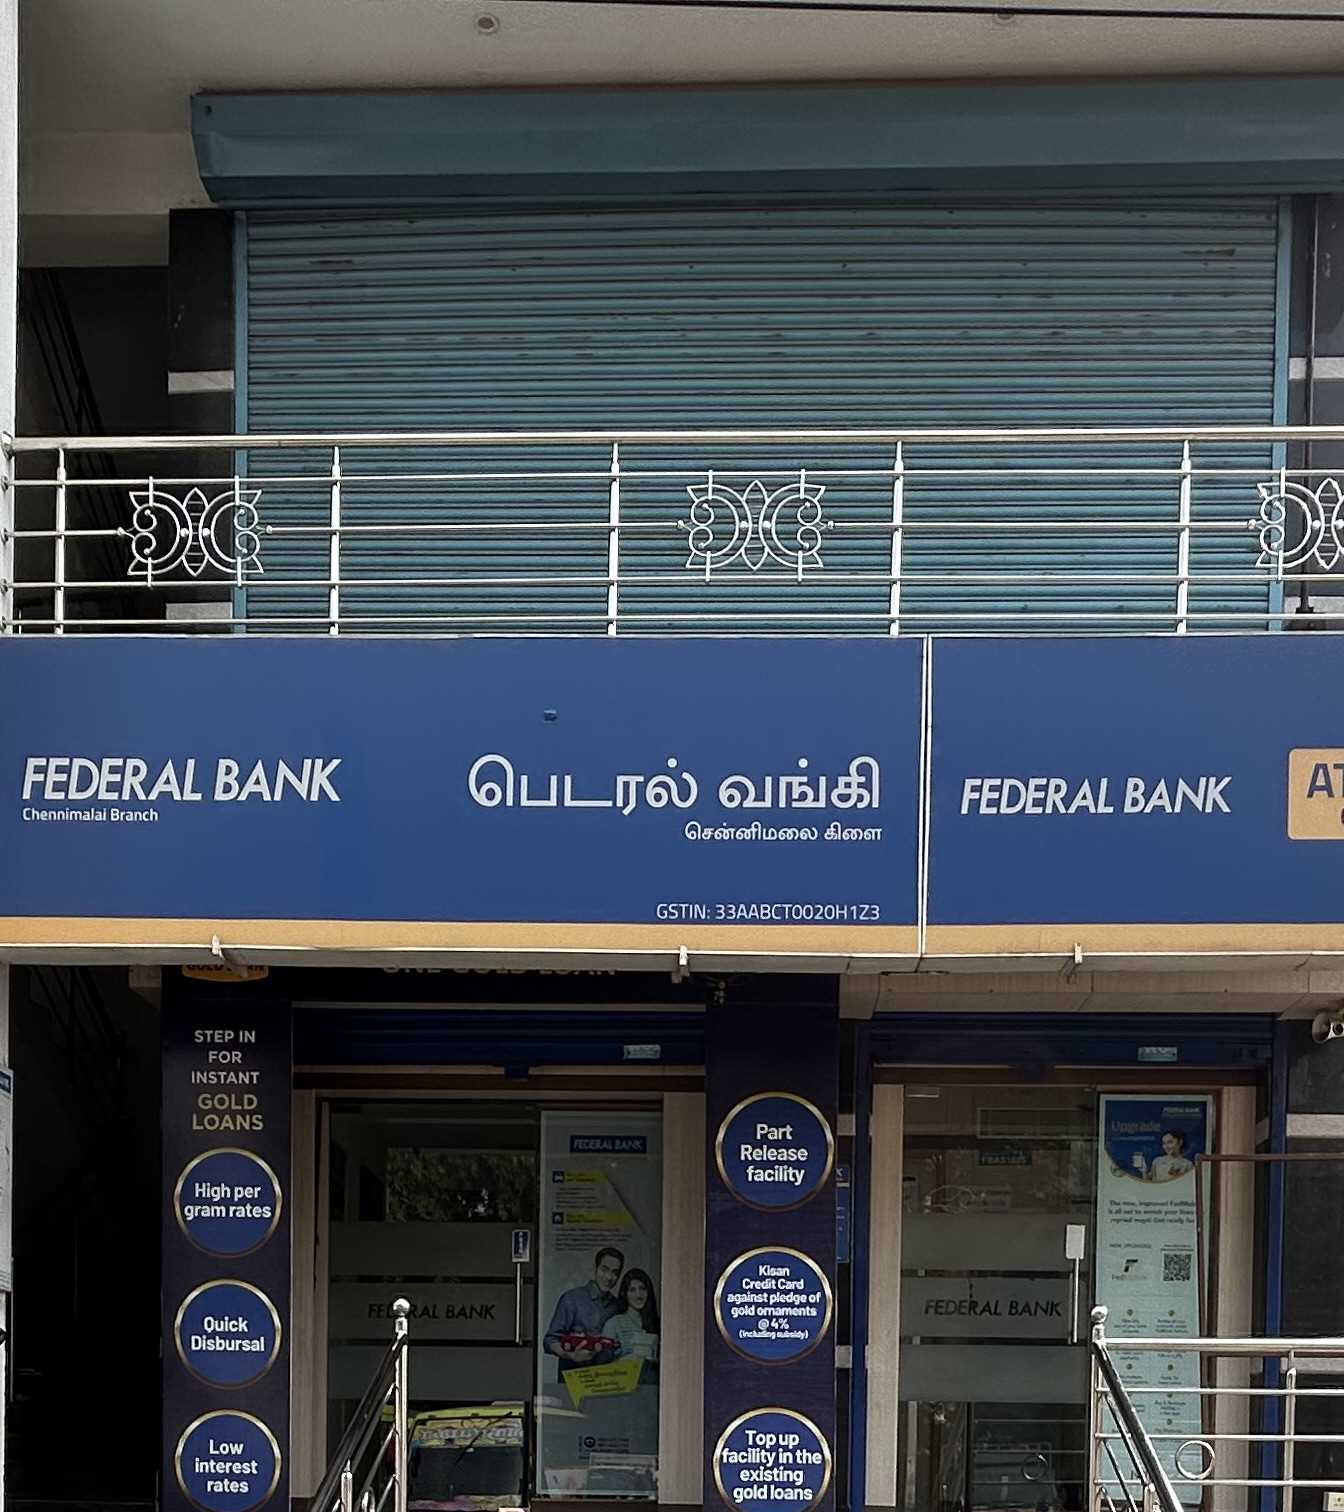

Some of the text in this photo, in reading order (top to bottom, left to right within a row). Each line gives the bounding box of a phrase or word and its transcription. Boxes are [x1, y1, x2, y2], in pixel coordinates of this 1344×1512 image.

[22, 756, 341, 802] FEDERAL BANK
[466, 752, 881, 816] பெடரல் வங்கி
[960, 775, 1231, 815] FEDERAL BANK
[22, 806, 158, 822] Chennimalai Branch
[684, 818, 882, 843] சென்னிமலை கிளை
[656, 903, 880, 920] GSTIN: 33AABCT0020H1Z3
[194, 1029, 256, 1043] STEP IN
[208, 1051, 242, 1064] FOR
[191, 1071, 260, 1084] INSTANT
[197, 1093, 258, 1110] GOLD
[192, 1114, 264, 1130] LOANS
[756, 1123, 793, 1142] Part
[740, 1145, 808, 1163] Release
[746, 1164, 805, 1186] facility
[194, 1182, 261, 1201] High per
[184, 1203, 272, 1220] gram rates
[759, 1264, 790, 1276] Kisan
[742, 1278, 804, 1289] Credit Card
[727, 1292, 821, 1305] against pledge of
[445, 1304, 495, 1319] BANK
[731, 1305, 817, 1318] gold ornaments
[923, 1298, 1062, 1317] FEDERAL BANK
[202, 1315, 248, 1333] Quick
[758, 1319, 769, 1330] @
[190, 1335, 265, 1352] Disbursal
[209, 1439, 244, 1456] Low
[745, 1430, 799, 1449] Top up
[722, 1447, 822, 1466] facility in the
[194, 1458, 258, 1476] interest
[740, 1466, 804, 1486] existing
[206, 1477, 249, 1493] rates
[733, 1484, 814, 1503] gold loans
